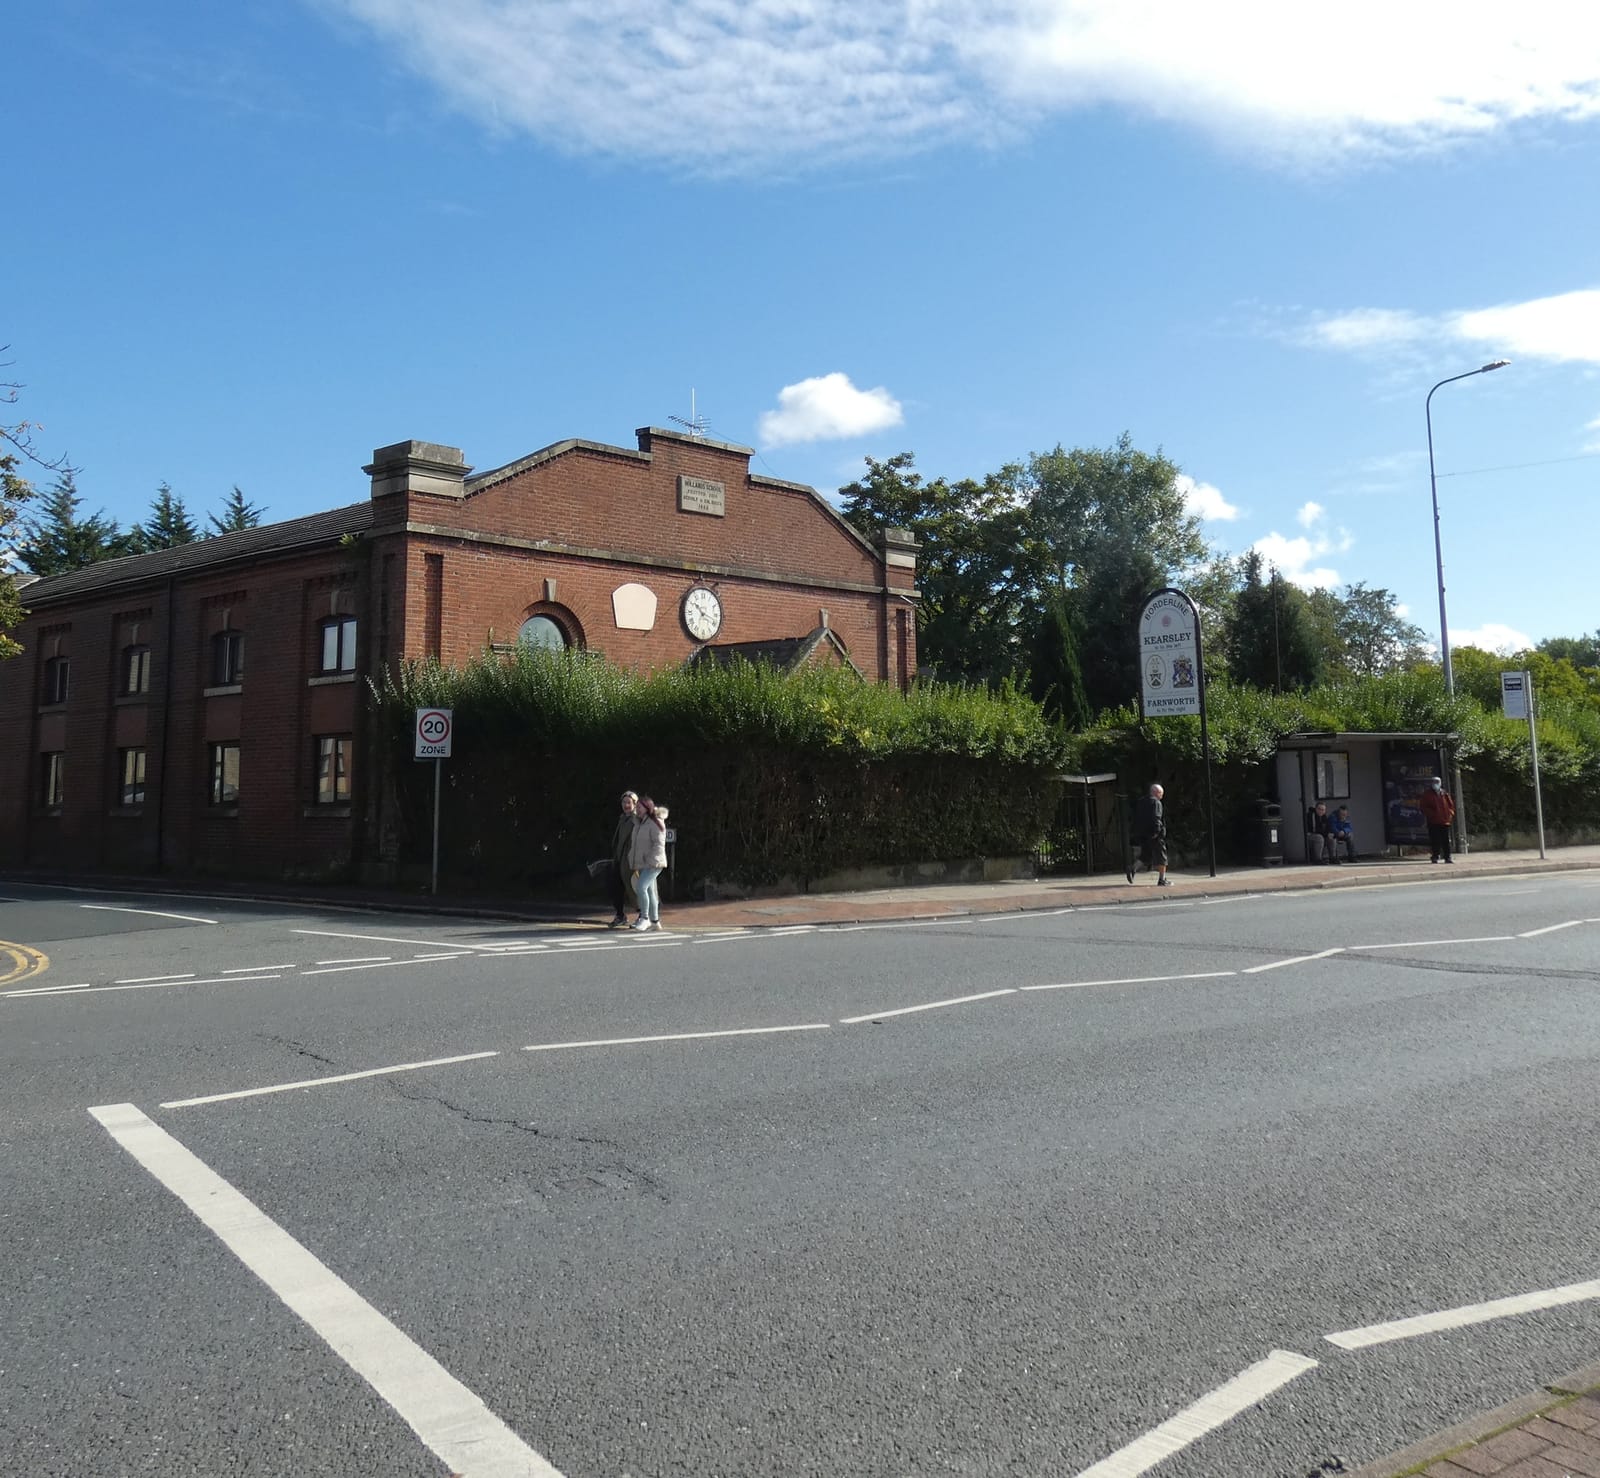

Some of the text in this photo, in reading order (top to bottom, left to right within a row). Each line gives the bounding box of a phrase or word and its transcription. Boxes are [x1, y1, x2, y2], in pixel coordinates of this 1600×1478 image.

[1144, 598, 1189, 621] BORDERLINE
[1144, 632, 1191, 645] KEARSLEY
[1147, 697, 1195, 707] FARNWORTH
[424, 720, 444, 734] 20
[421, 746, 446, 754] ZONE
